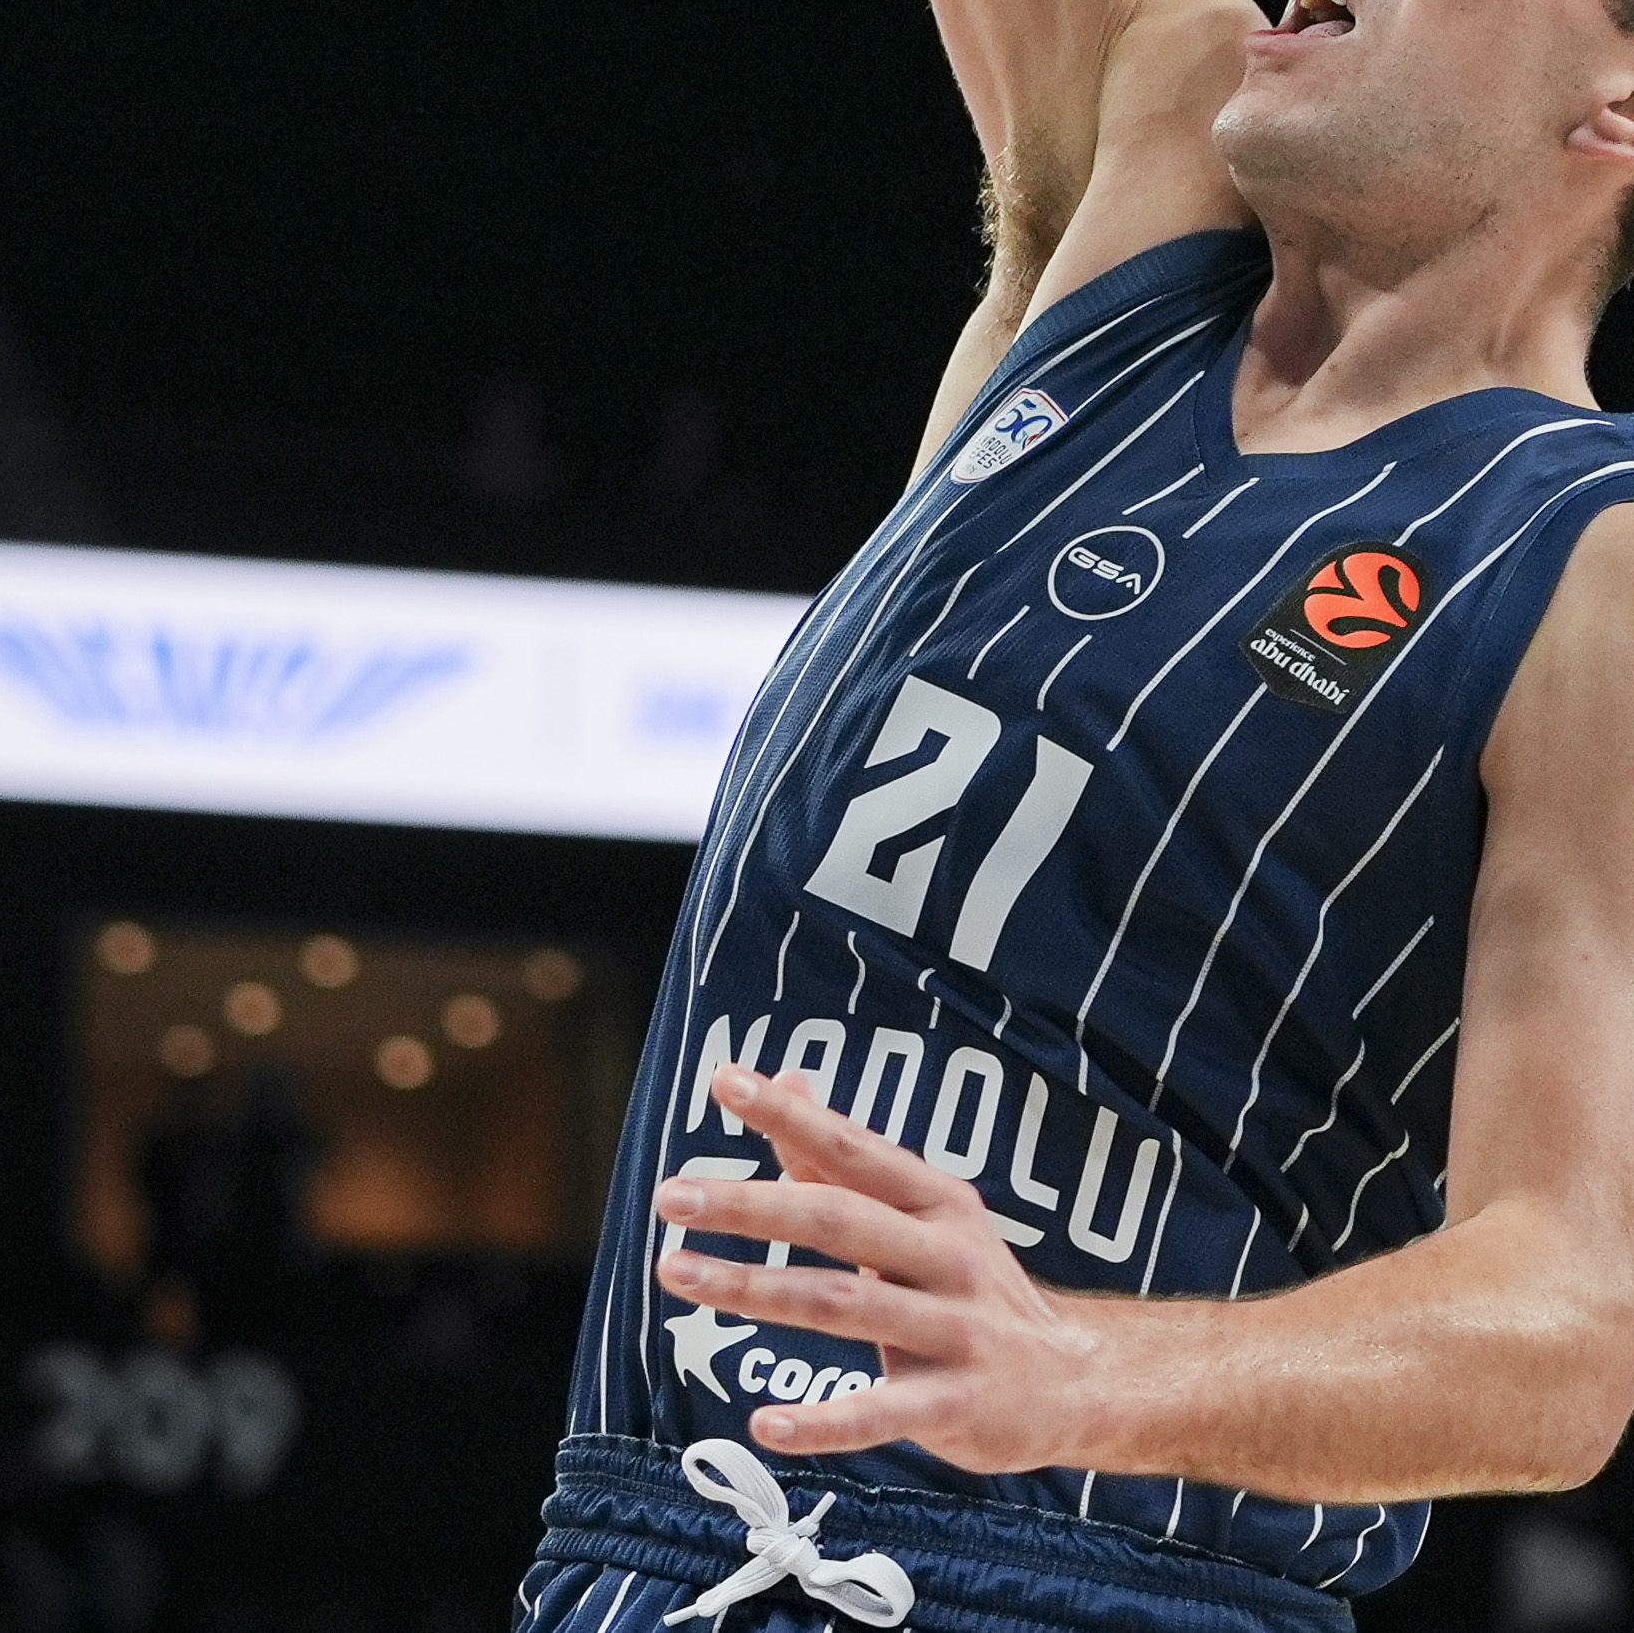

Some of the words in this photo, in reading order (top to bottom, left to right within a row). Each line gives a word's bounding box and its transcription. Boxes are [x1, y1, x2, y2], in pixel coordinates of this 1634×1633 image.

[994, 398, 1053, 450] 50
[1068, 547, 1141, 595] GSA
[1250, 639, 1291, 668] abu
[1265, 628, 1316, 662] experience
[803, 674, 1095, 972] 21
[738, 1347, 889, 1406] core
